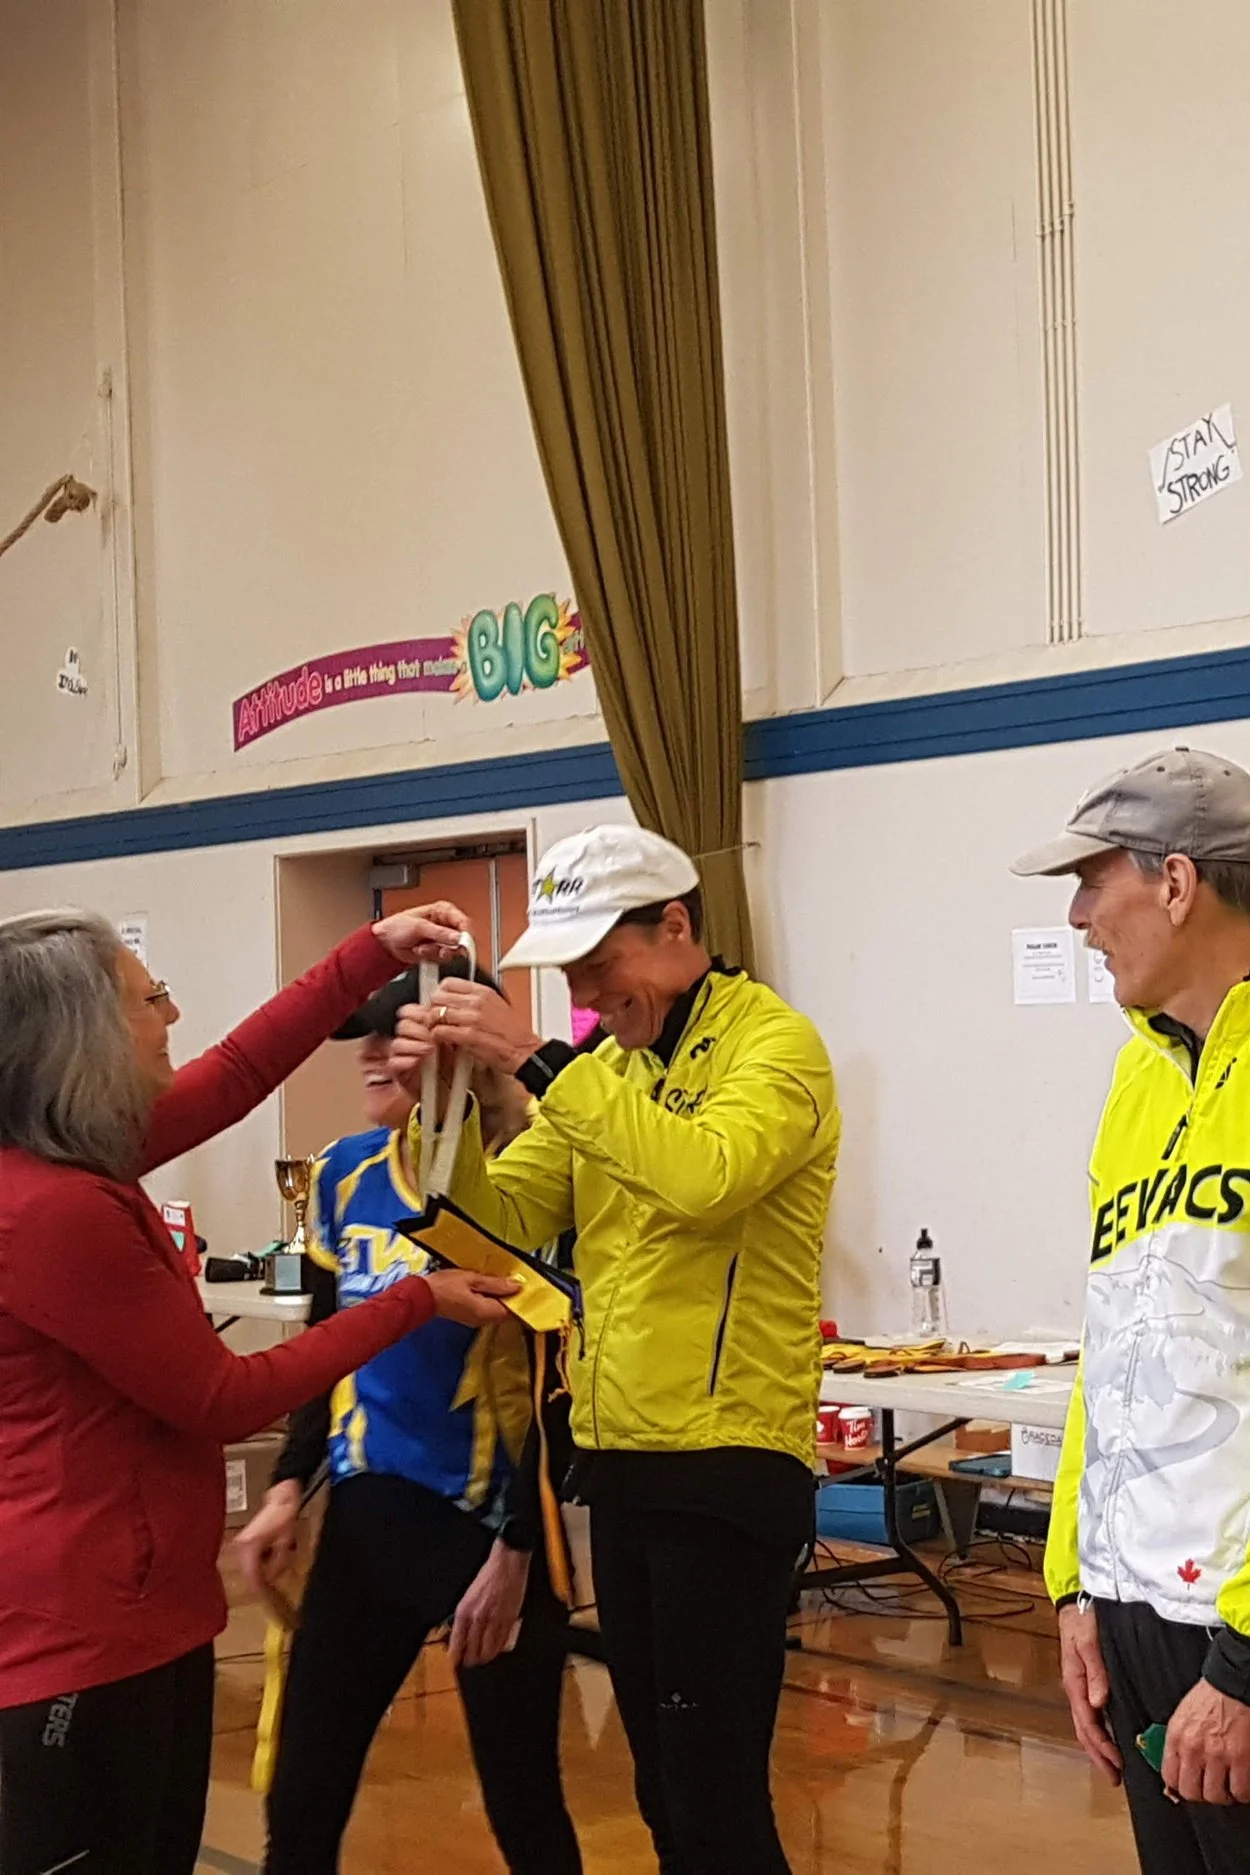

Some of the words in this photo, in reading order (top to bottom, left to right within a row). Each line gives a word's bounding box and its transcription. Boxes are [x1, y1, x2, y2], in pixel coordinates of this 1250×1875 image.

[1169, 412, 1213, 472] STAY
[1166, 454, 1230, 514] STRONG
[467, 593, 560, 702] BIG
[238, 666, 322, 743] Attitude
[325, 674, 333, 693] is
[335, 677, 341, 691] a
[343, 666, 367, 689] little
[369, 661, 395, 685] thing
[398, 659, 420, 680] that
